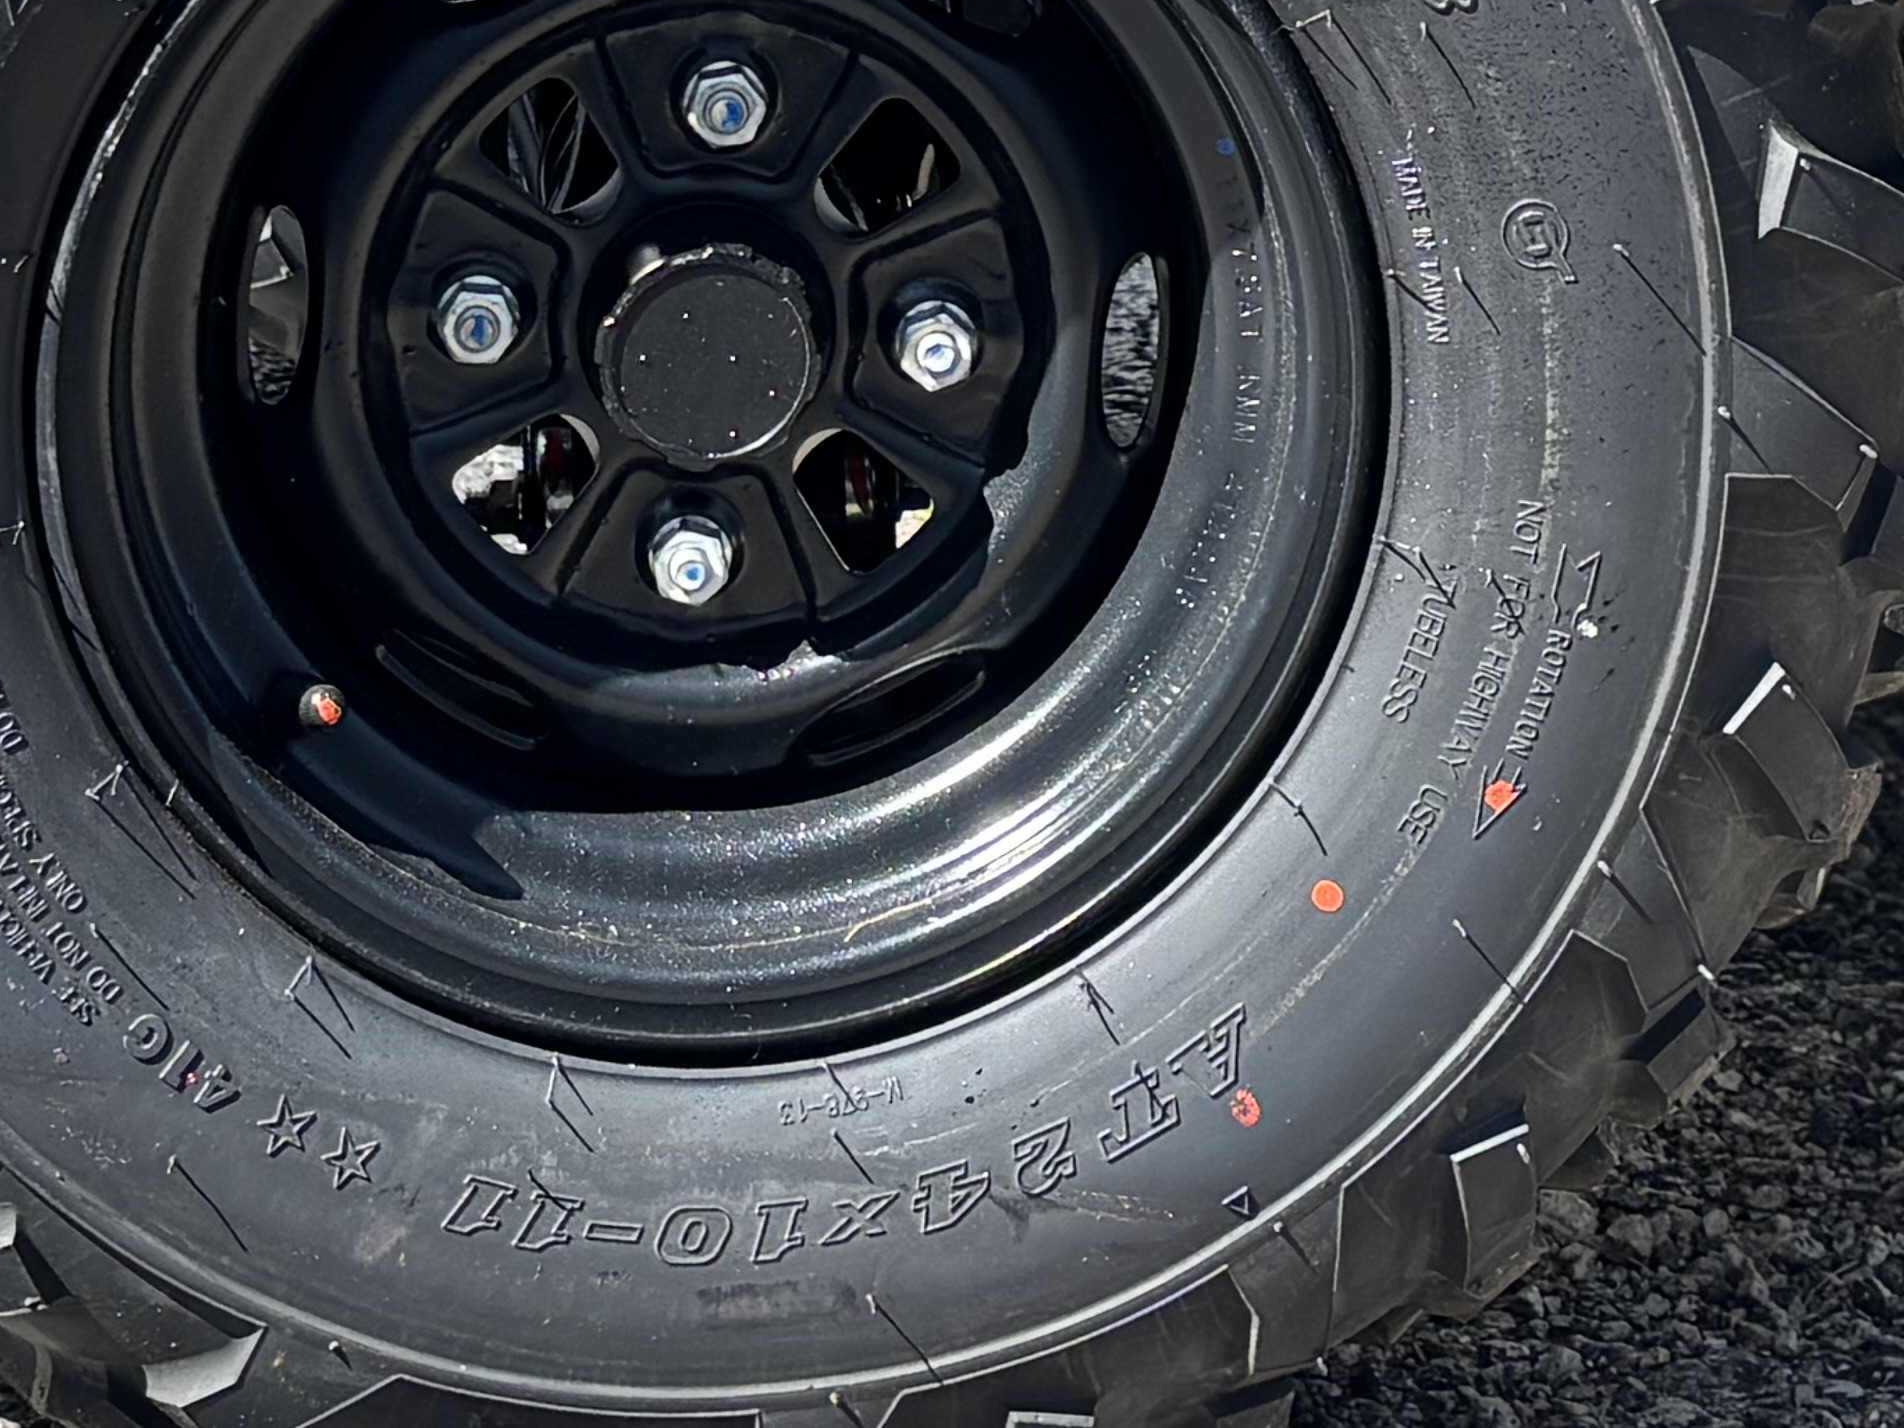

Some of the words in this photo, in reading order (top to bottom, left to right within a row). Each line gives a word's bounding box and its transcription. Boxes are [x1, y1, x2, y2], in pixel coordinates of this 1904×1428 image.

[1391, 157, 1432, 221] MADE
[1412, 226, 1437, 251] IN
[1419, 256, 1450, 344] TAIWAN
[1507, 499, 1546, 565] NOT
[1489, 574, 1532, 639] FOR
[1382, 578, 1458, 724] TUBELESS
[1437, 646, 1510, 781] HIGHWAY
[1505, 628, 1574, 761] ROTATION
[1397, 783, 1448, 845] USE
[27, 845, 90, 916] ONLY
[39, 914, 91, 969] NOT
[51, 976, 104, 1030] SEE
[80, 960, 126, 1006] DO
